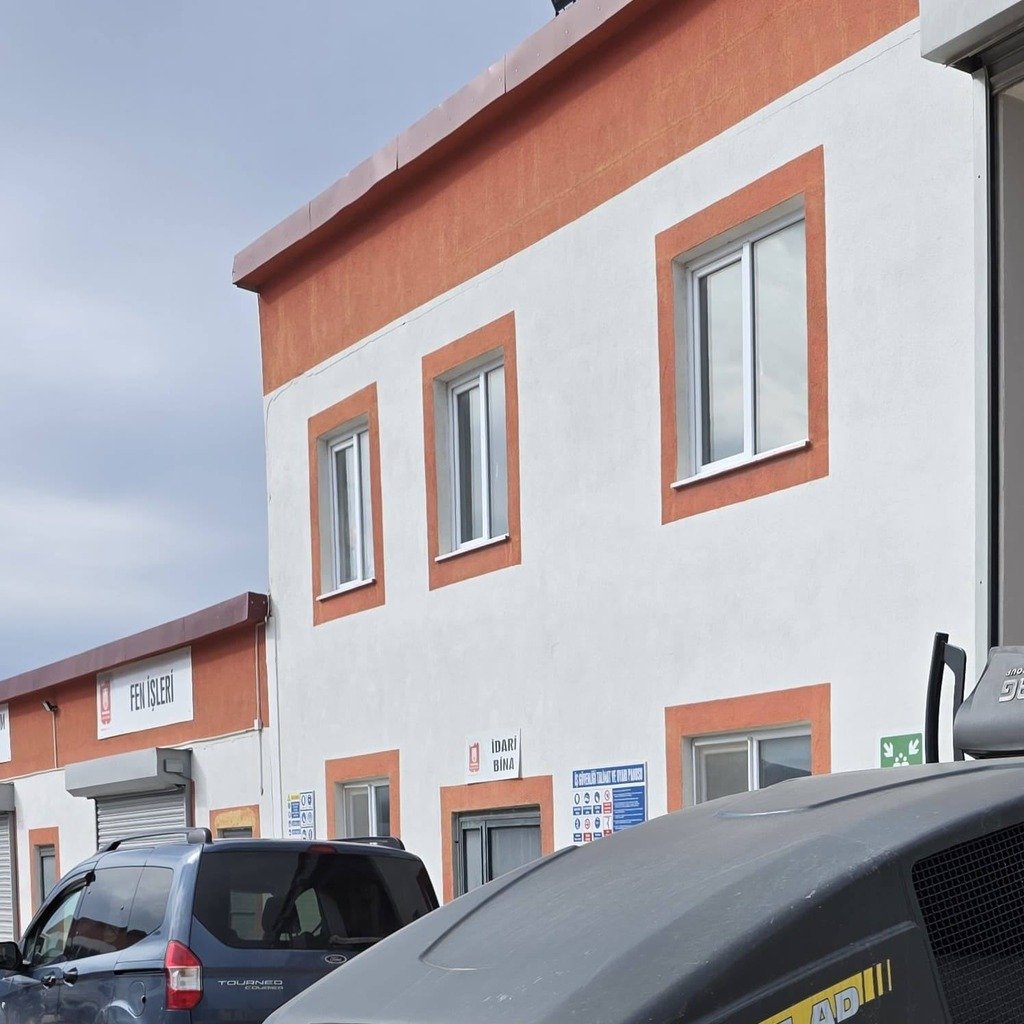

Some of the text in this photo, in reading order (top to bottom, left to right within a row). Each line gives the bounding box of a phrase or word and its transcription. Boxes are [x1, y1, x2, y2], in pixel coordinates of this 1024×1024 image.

[130, 668, 174, 712] FEN İŞLERİ
[491, 735, 517, 754] İDARİ
[493, 756, 515, 772] BİNA
